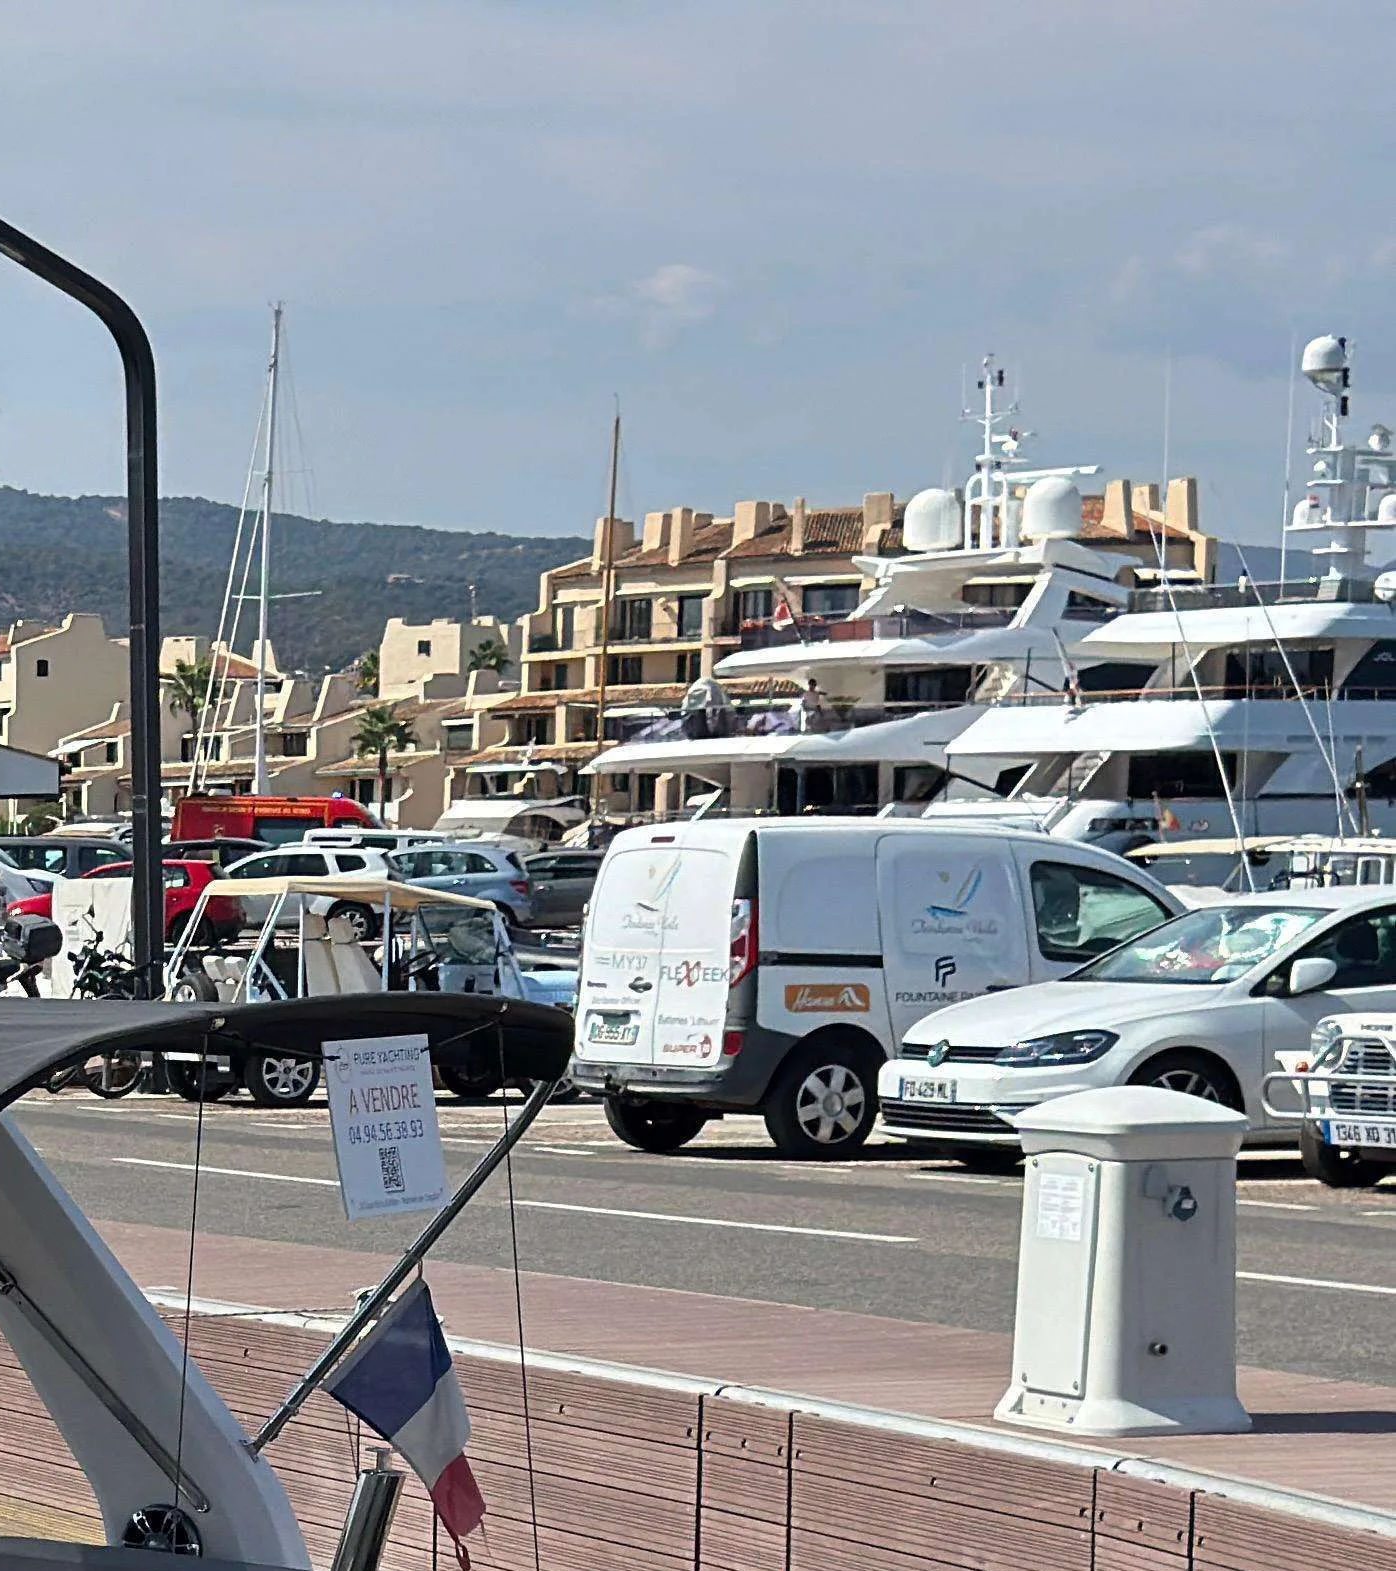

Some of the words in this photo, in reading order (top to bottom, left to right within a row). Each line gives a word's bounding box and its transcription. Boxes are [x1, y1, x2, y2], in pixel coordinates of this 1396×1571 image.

[353, 1051, 377, 1065] PURE
[349, 1088, 359, 1115] A
[362, 1083, 422, 1113] VENDRE
